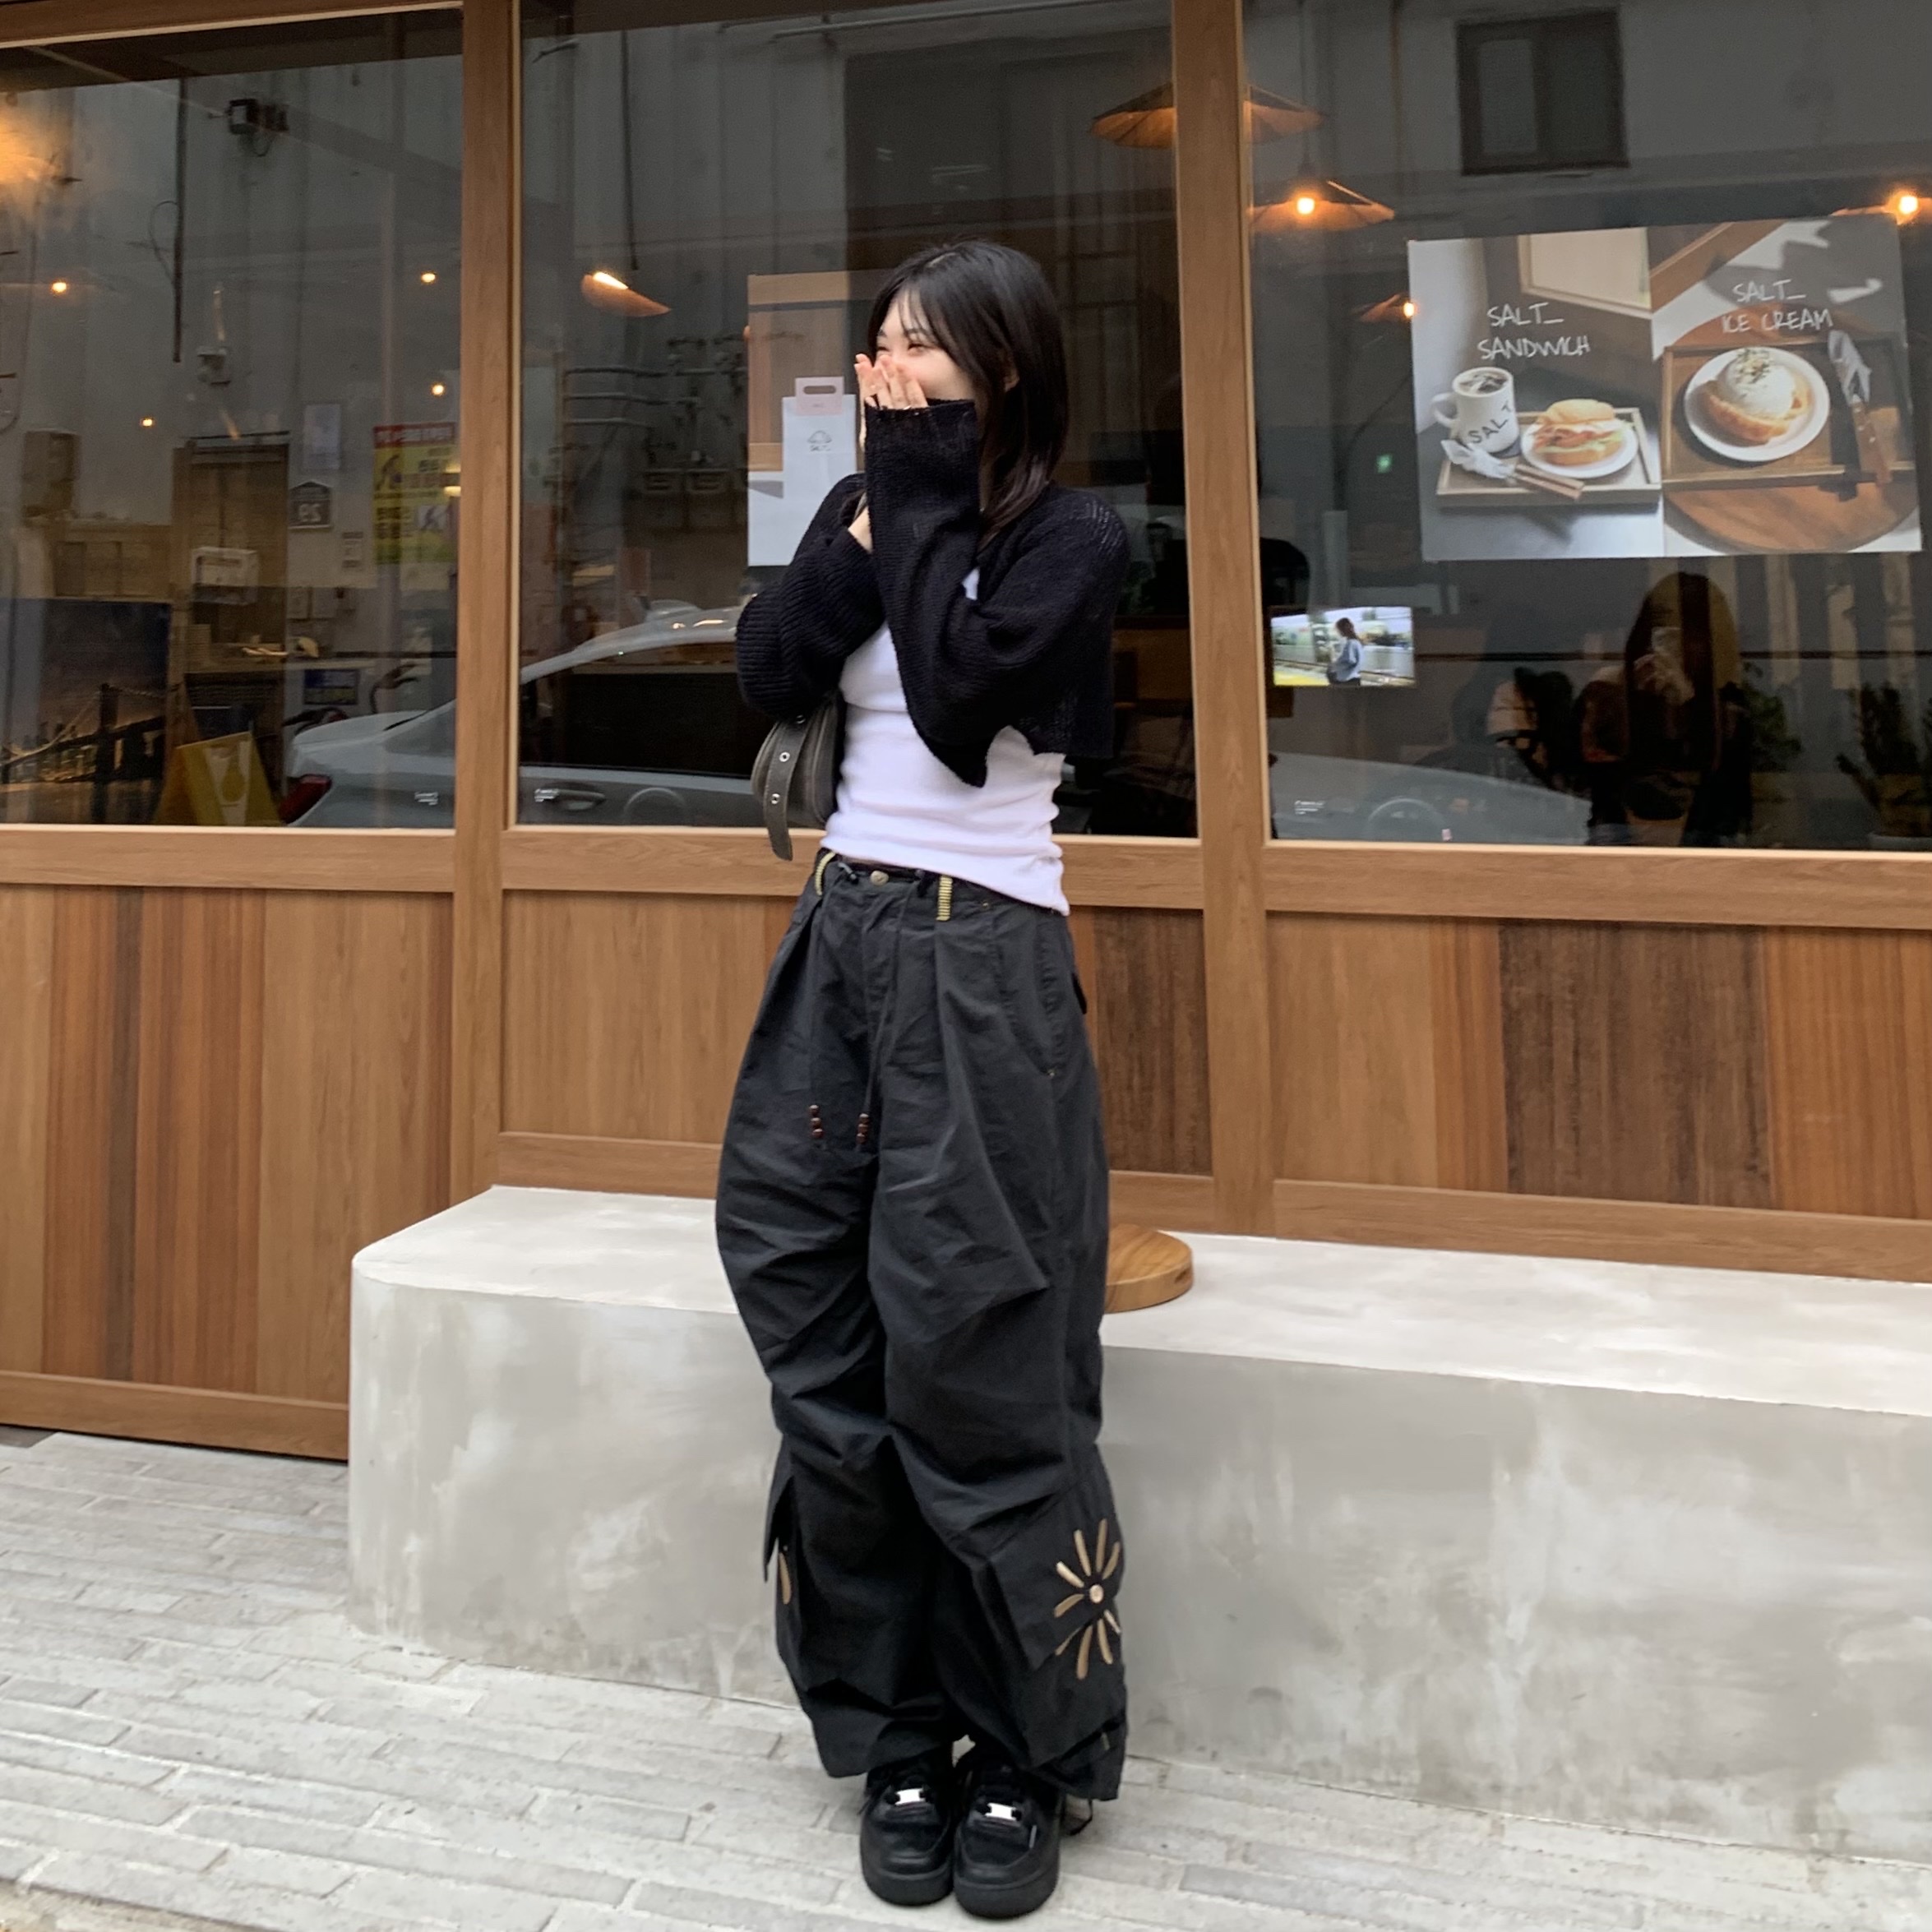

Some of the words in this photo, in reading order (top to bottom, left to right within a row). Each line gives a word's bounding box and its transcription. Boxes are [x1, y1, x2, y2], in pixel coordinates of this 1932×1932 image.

[1722, 313, 1752, 334] ICE
[1761, 307, 1834, 330] CREAM
[1477, 335, 1591, 360] SANDWICH
